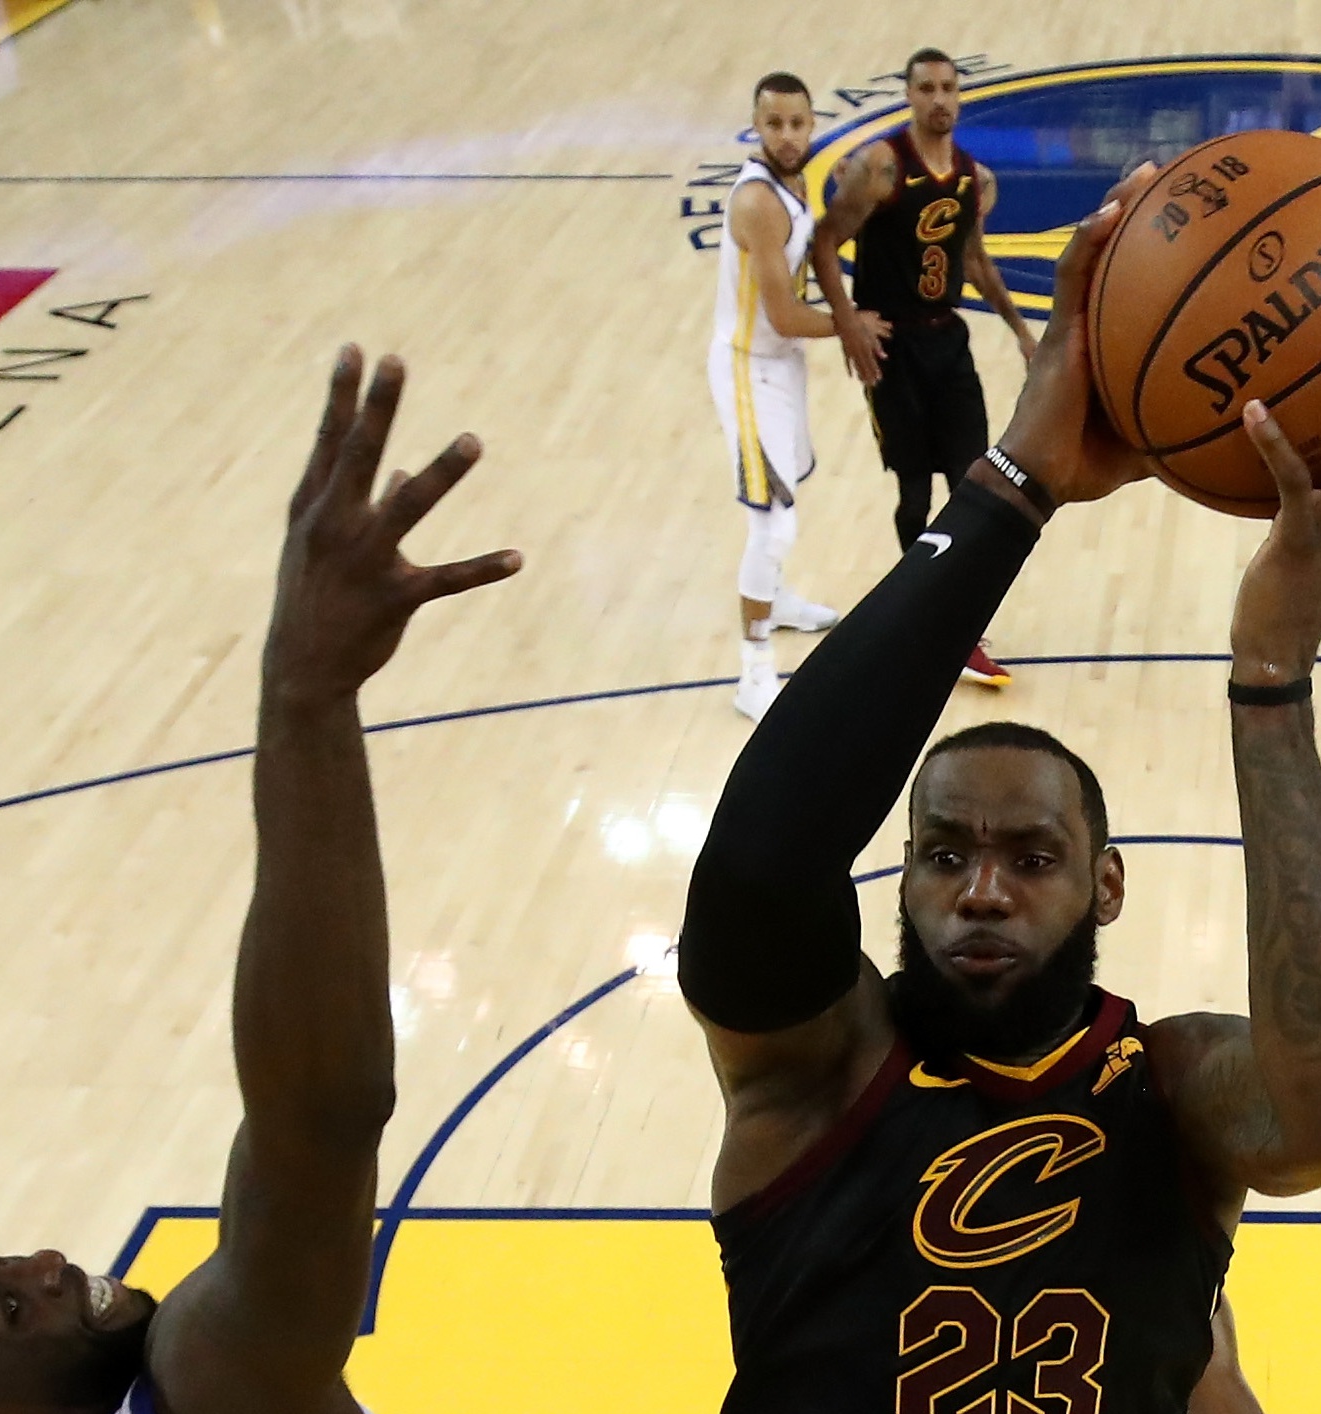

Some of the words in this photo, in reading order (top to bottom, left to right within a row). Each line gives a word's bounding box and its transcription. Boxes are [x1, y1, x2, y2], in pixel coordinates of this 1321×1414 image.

[1150, 201, 1191, 244] 20
[1211, 155, 1250, 182] 18
[919, 245, 949, 299] 3
[984, 447, 1028, 487] OMISE
[912, 1113, 1106, 1269] C
